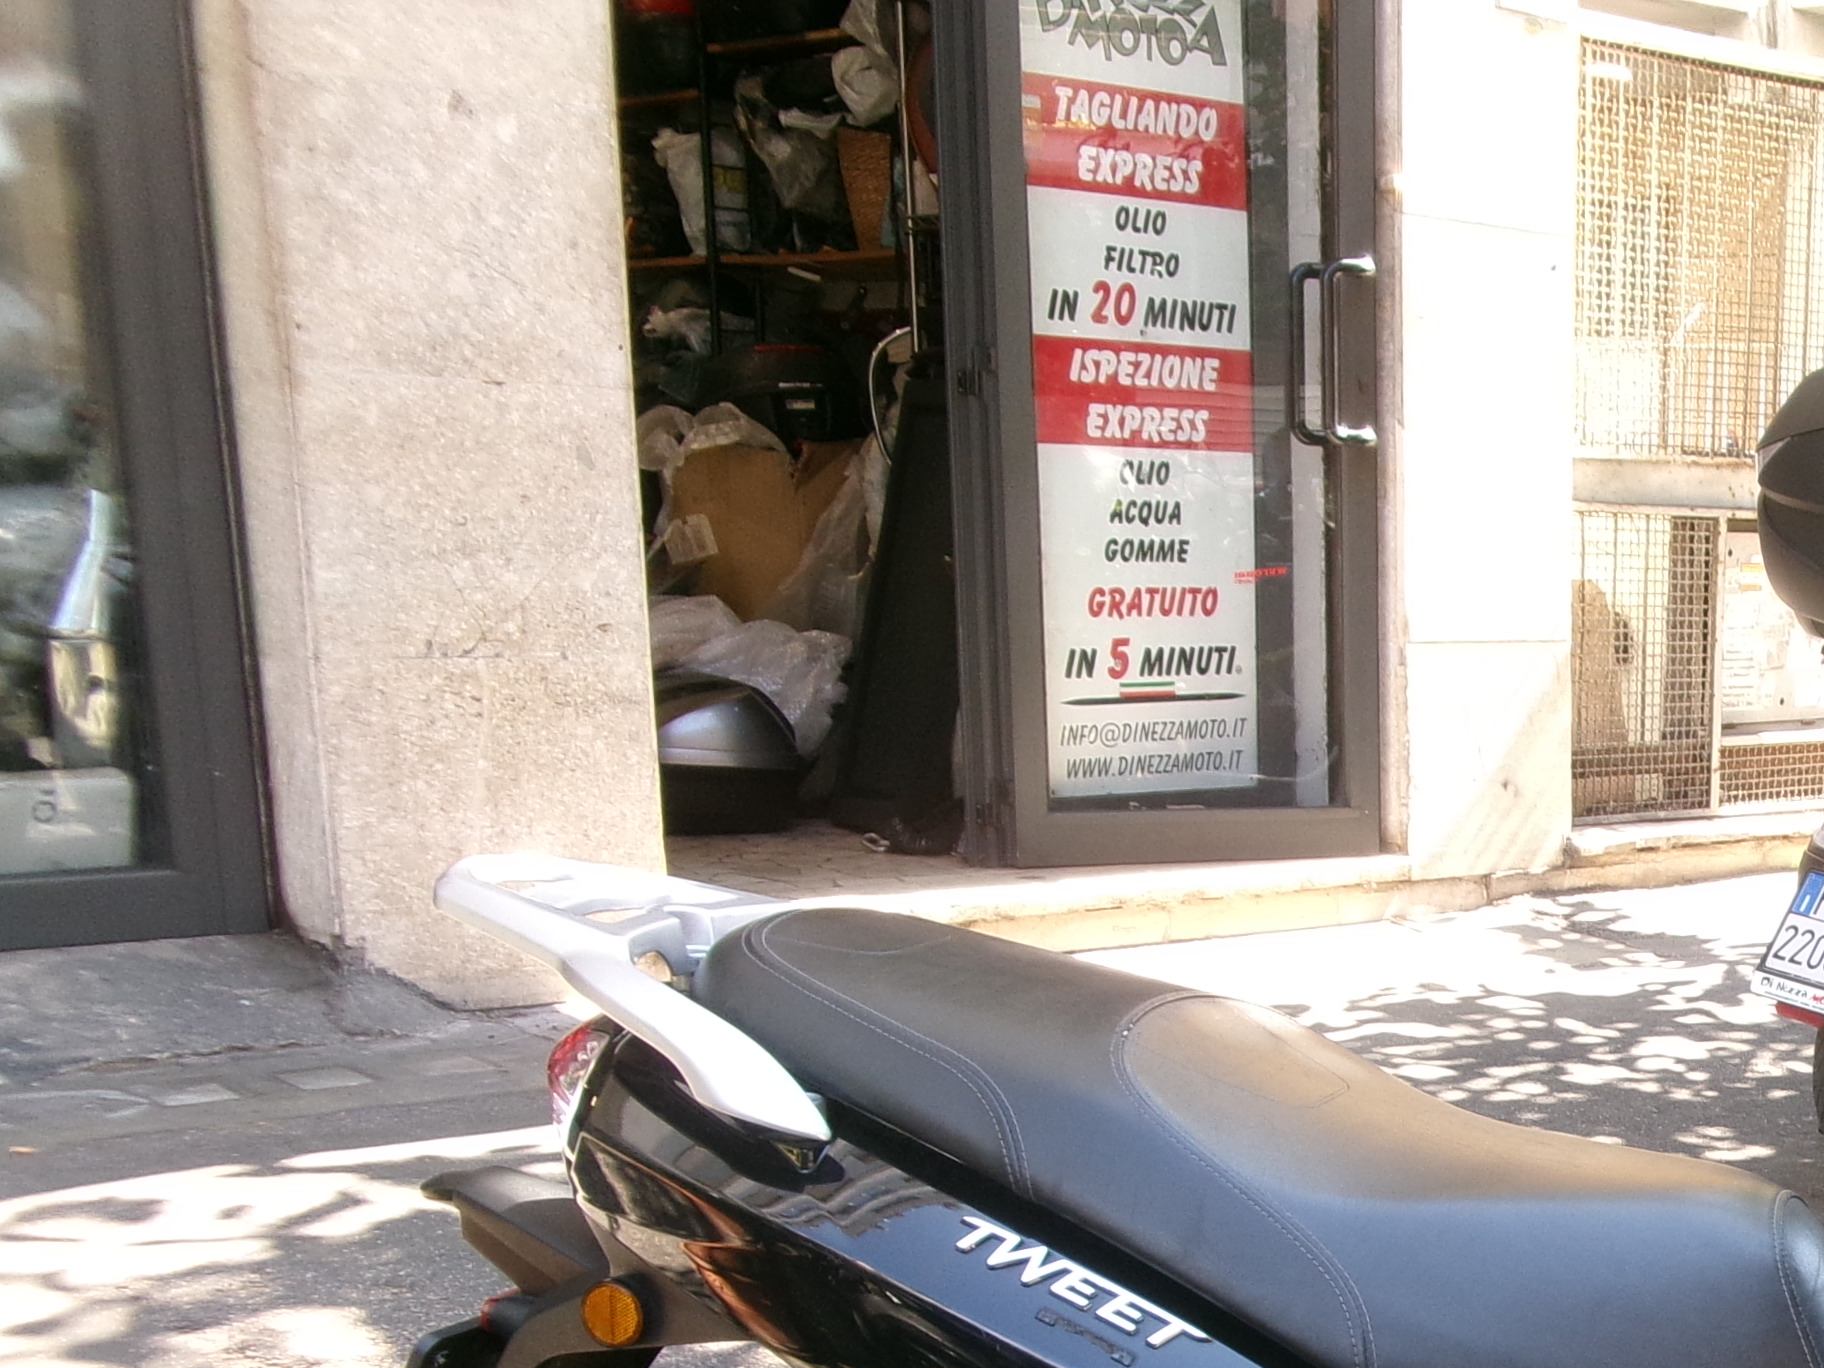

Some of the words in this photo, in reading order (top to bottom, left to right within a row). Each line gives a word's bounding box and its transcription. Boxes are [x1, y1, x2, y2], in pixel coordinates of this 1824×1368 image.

[1054, 85, 1219, 142] TAGLIANDO
[1077, 145, 1203, 195] EXPRESS
[1115, 205, 1167, 236] OLIO
[1104, 245, 1180, 279] FILTRO
[1048, 288, 1080, 322] IN
[1091, 279, 1136, 326] 20
[1144, 296, 1237, 334] MINUTI
[1069, 347, 1220, 391] ISPEZIONE
[1086, 403, 1210, 443] EXPRESS
[1119, 459, 1170, 486] OLIO
[1109, 498, 1182, 527] ACQUA
[1104, 537, 1190, 563] GOMME
[1087, 586, 1219, 620] GRATUITO
[1064, 648, 1098, 679] IN
[1107, 637, 1130, 680] 5
[1060, 717, 1248, 748] INFO@DINEZZAMOTO.IT
[1066, 749, 1243, 779] WWW.DINEZZAMOTO.IT
[955, 1215, 1213, 1350] TWEET
